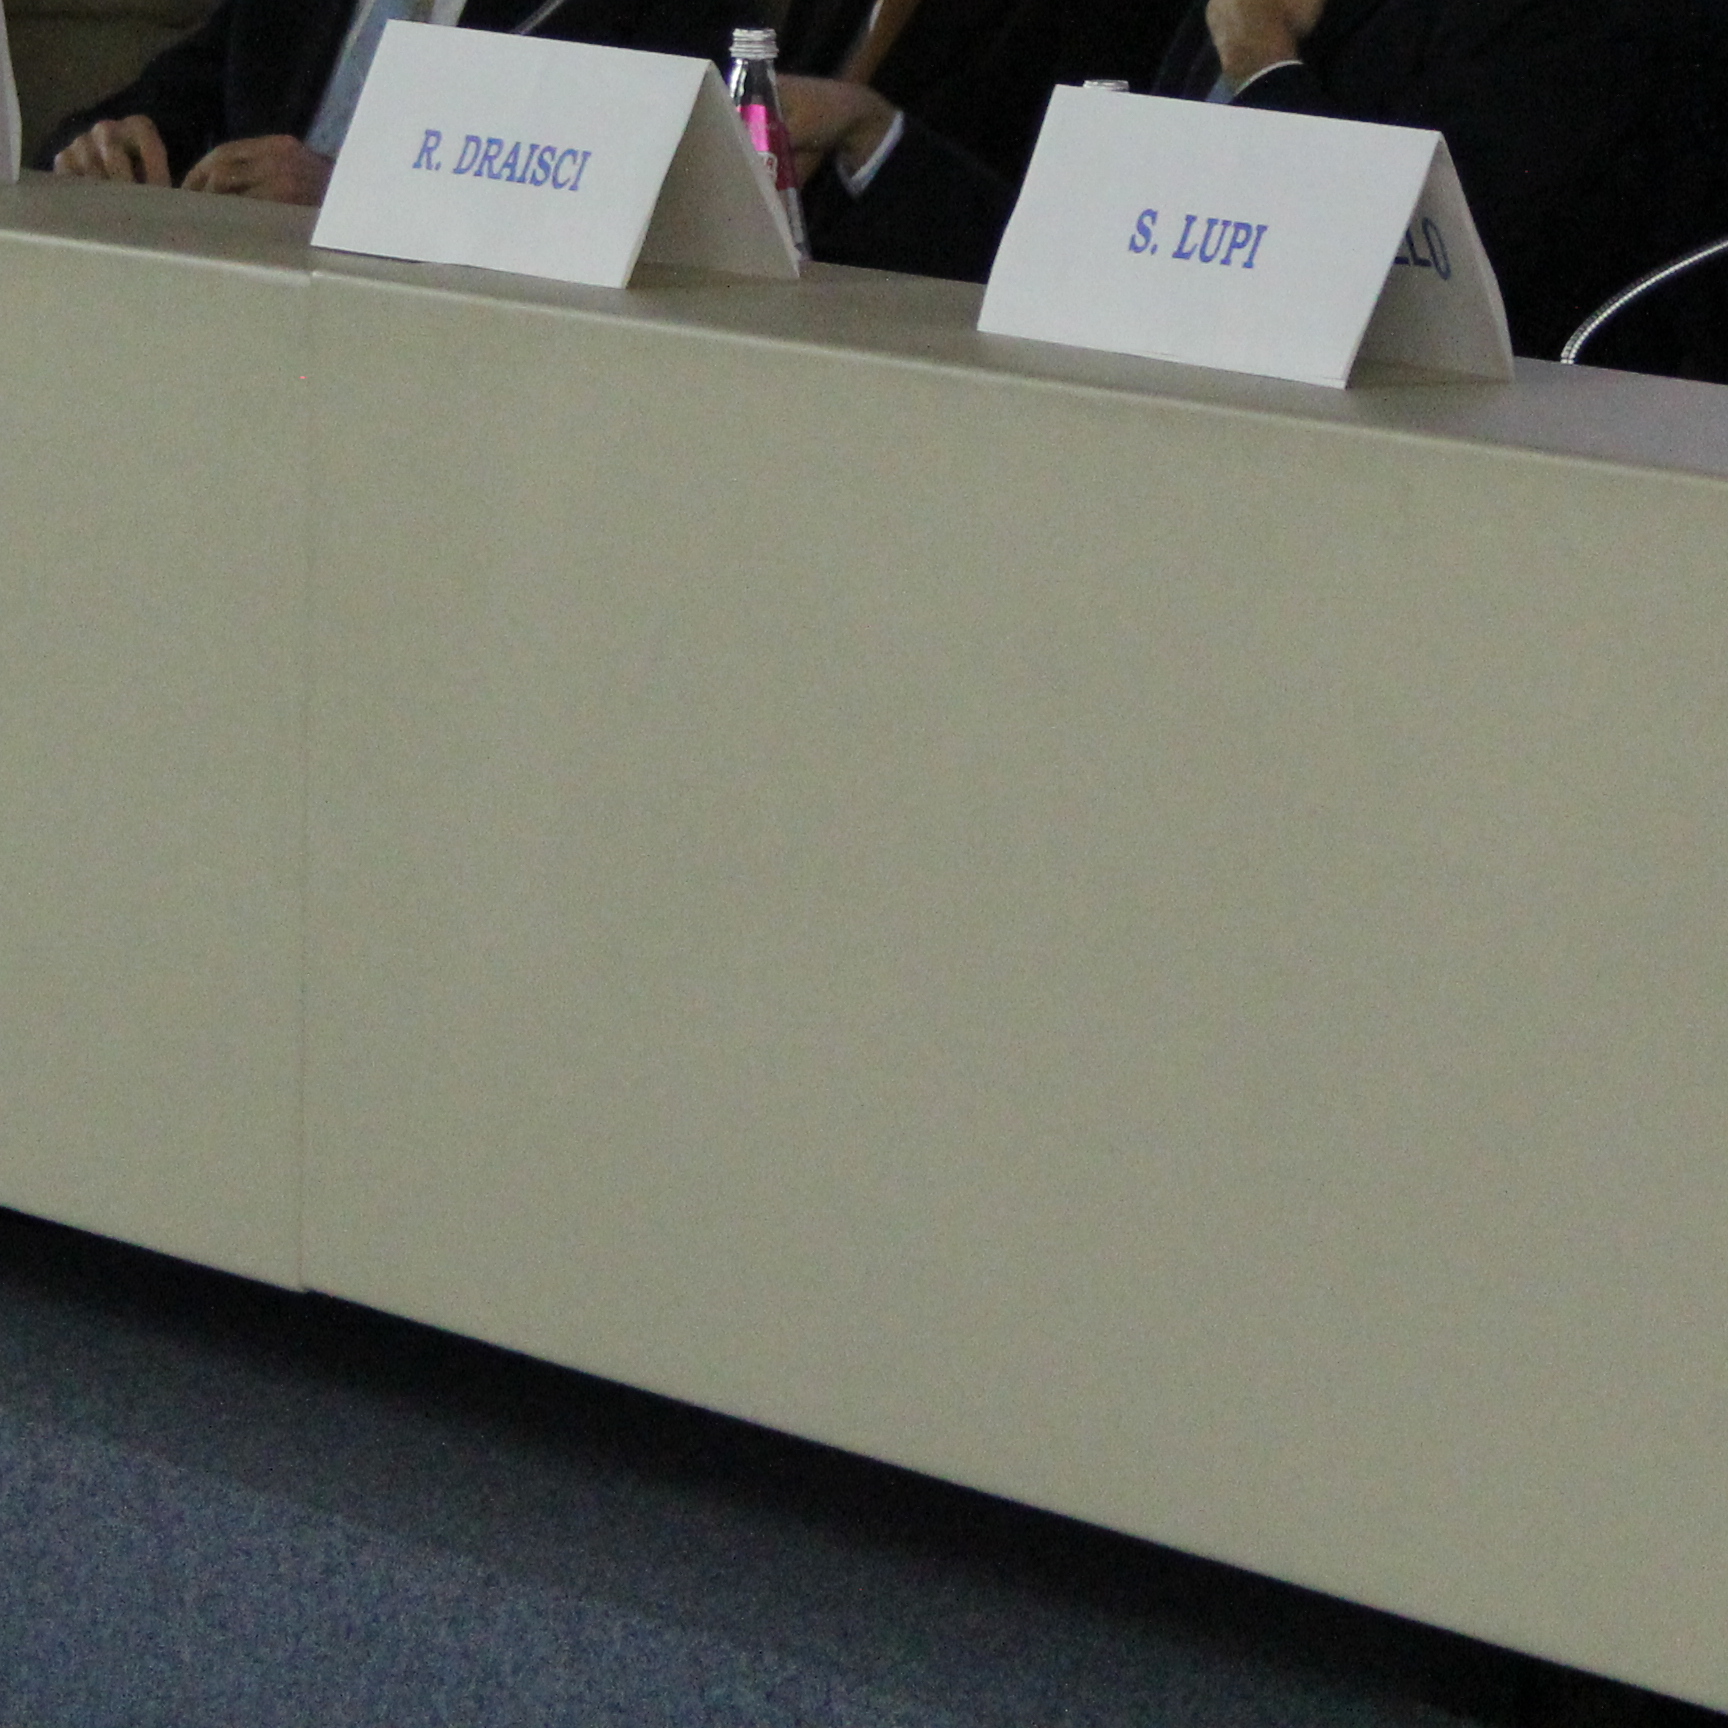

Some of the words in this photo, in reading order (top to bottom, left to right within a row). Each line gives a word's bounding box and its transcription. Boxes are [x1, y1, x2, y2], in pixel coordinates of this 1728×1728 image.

[412, 129, 442, 171] R.
[452, 134, 592, 191] DRAISCI
[1128, 209, 1159, 255] S.
[1172, 214, 1268, 269] LUPI
